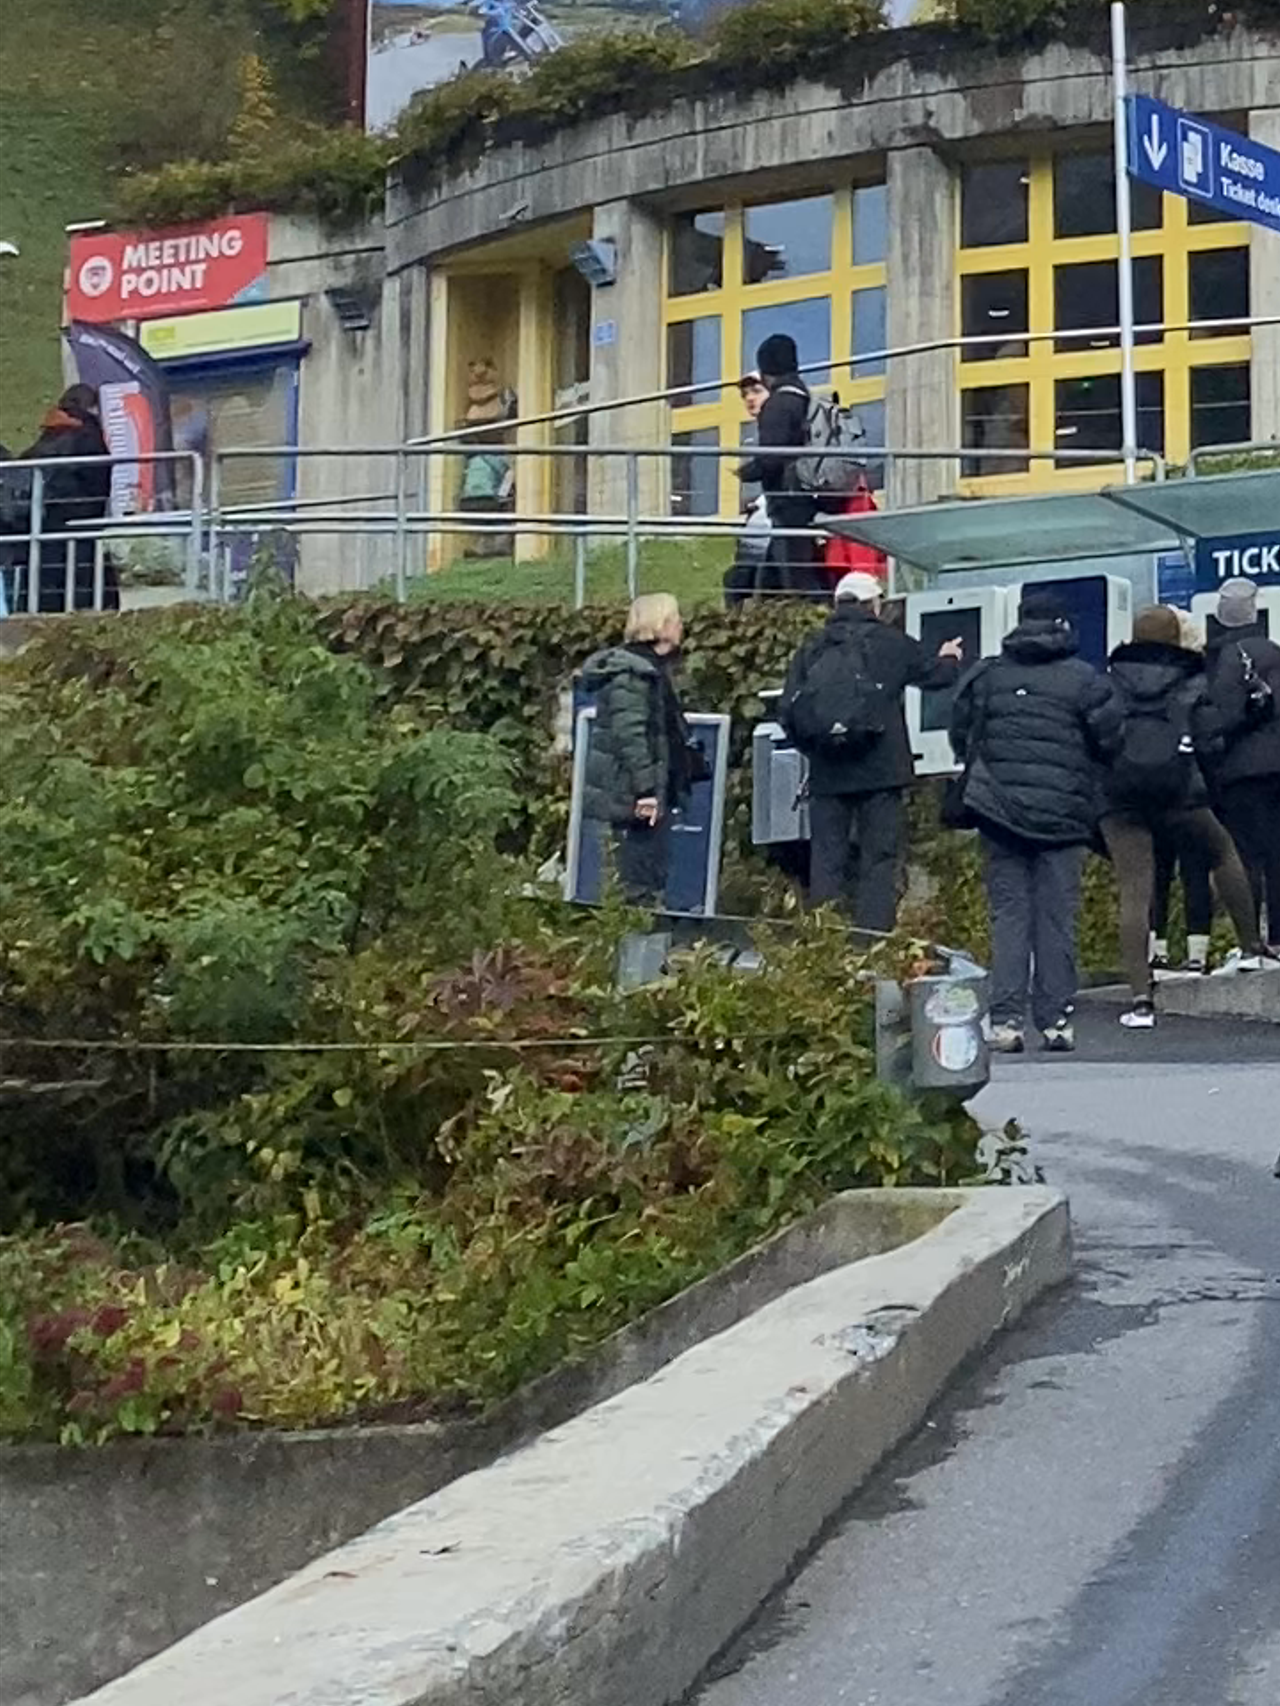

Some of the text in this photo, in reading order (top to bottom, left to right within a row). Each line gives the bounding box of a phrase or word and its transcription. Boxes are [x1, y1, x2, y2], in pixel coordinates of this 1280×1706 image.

[1219, 141, 1266, 182] Kasse
[1219, 175, 1257, 207] Ticket
[121, 229, 243, 270] MEETING
[120, 264, 207, 298] POINT
